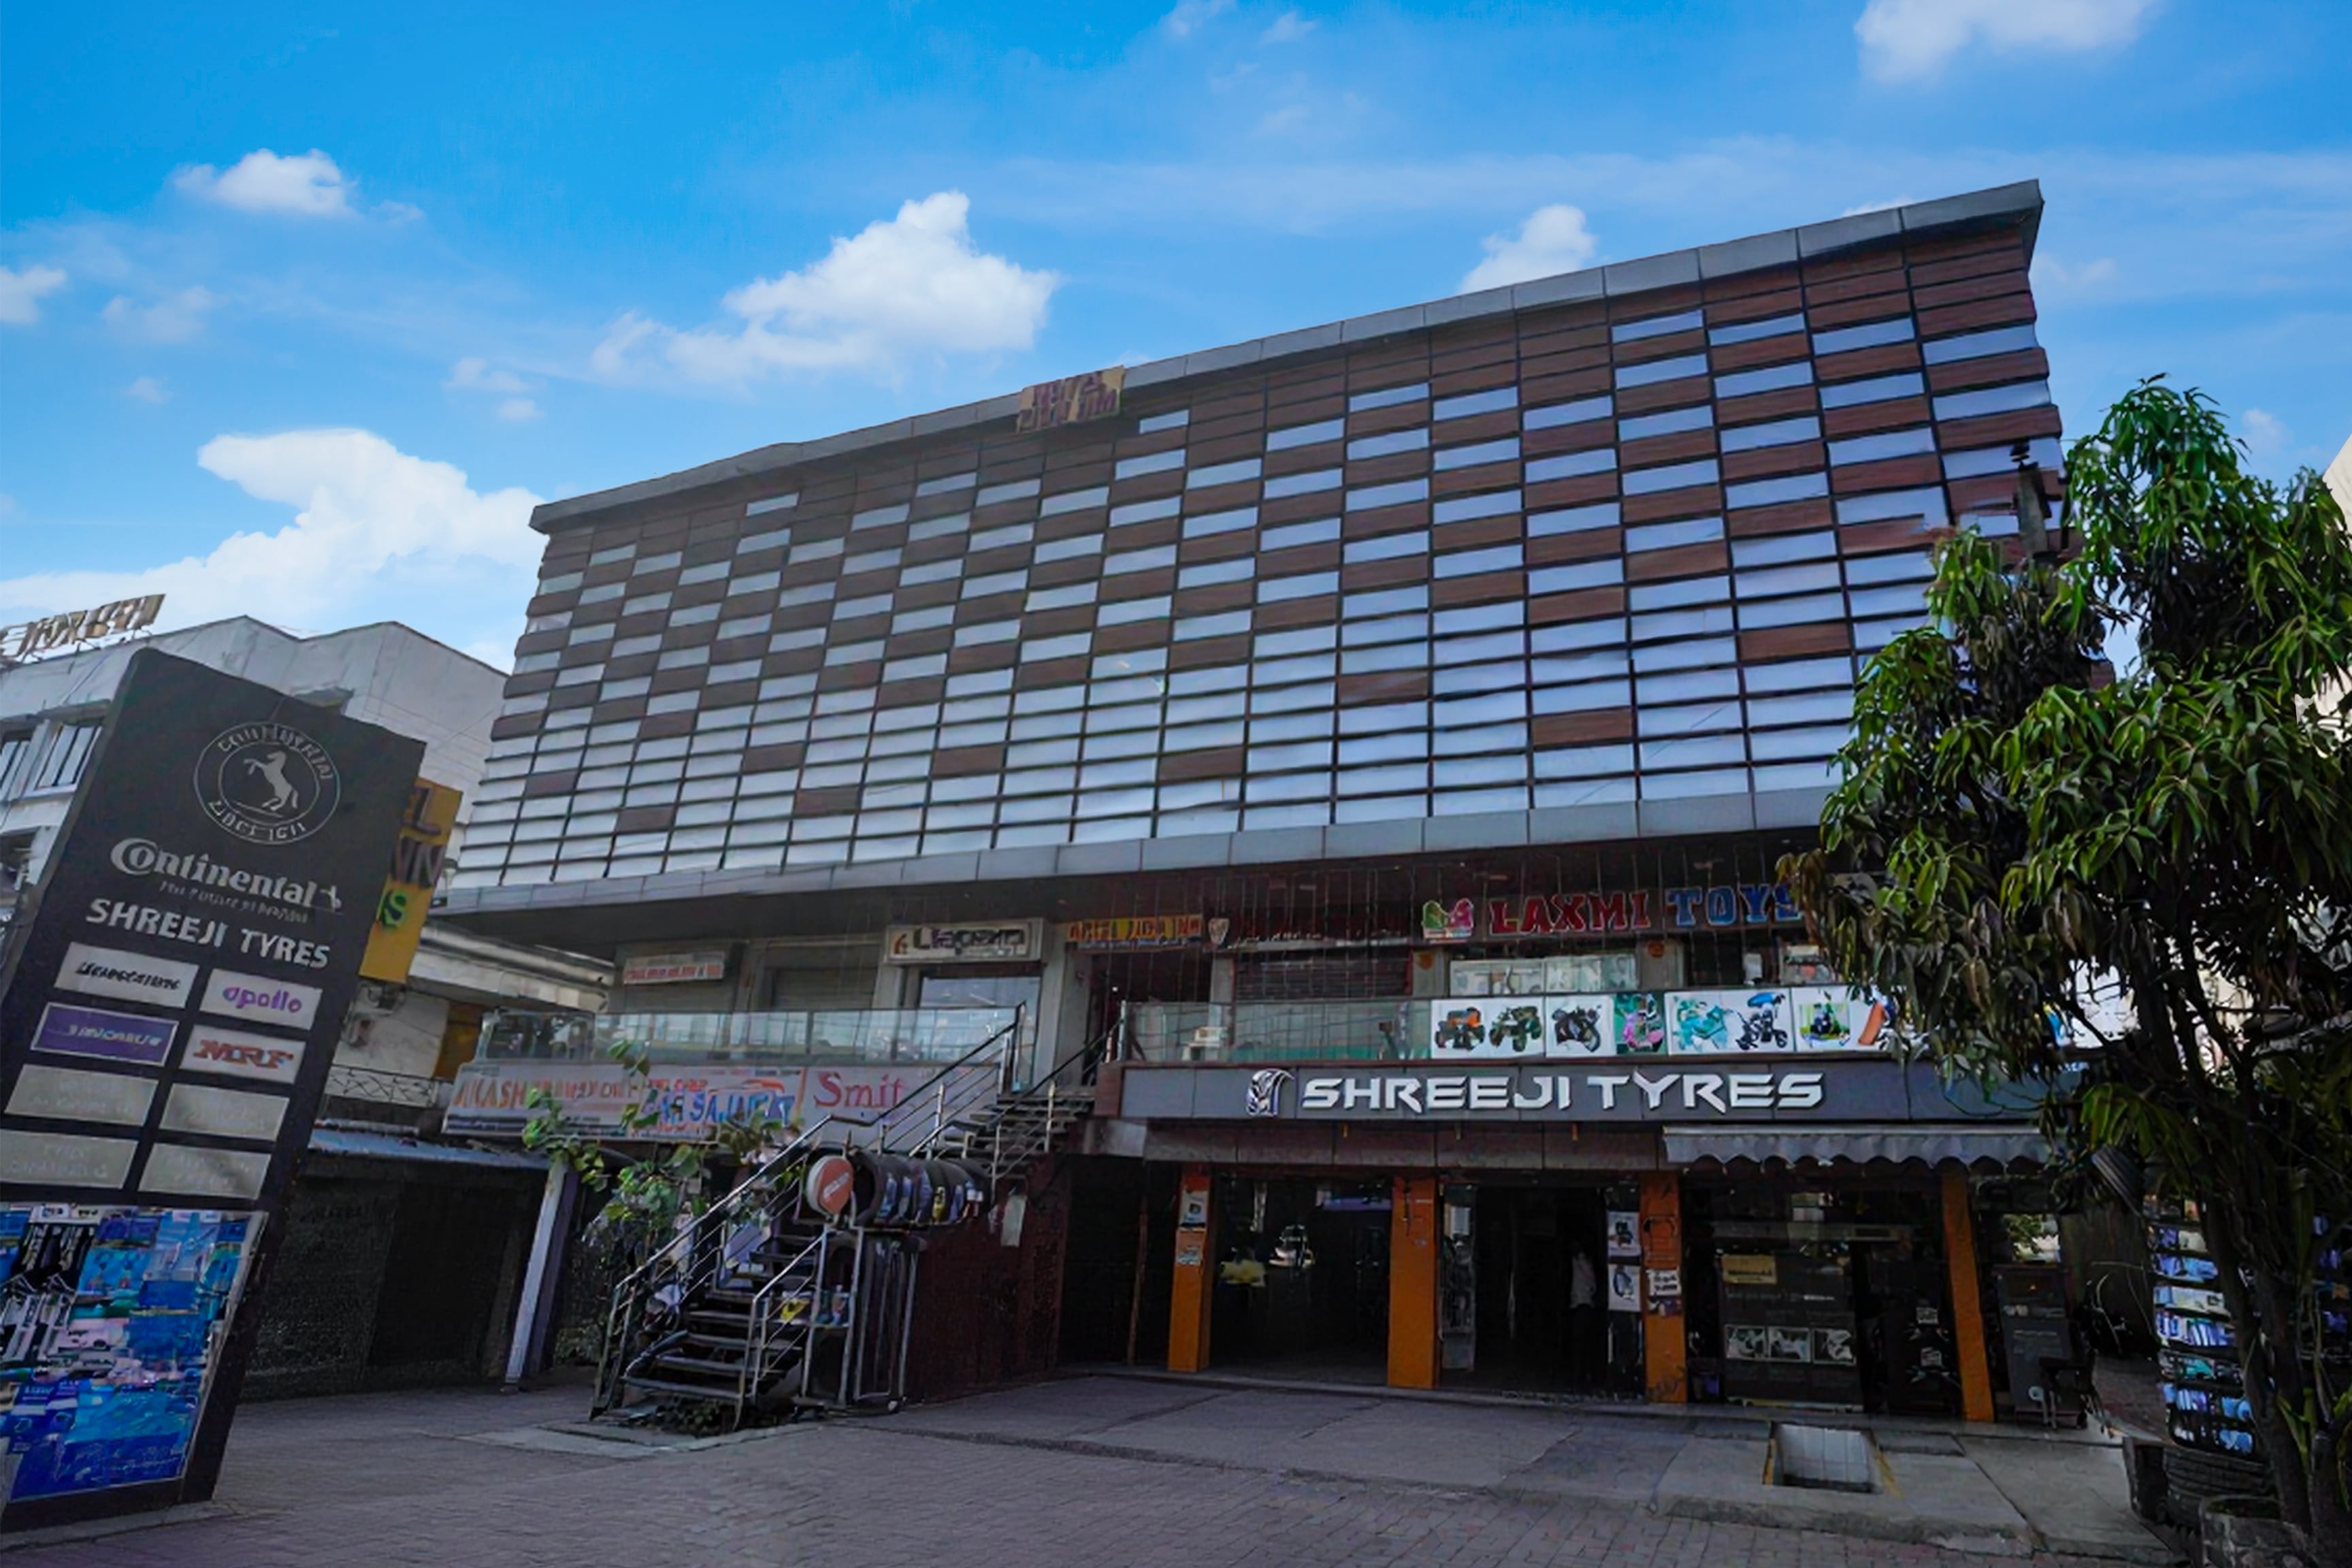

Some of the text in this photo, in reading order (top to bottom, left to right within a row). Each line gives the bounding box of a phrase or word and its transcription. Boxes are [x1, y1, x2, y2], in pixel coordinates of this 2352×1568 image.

[110, 837, 318, 908] Continental
[86, 898, 229, 947] SHREEJI
[240, 928, 331, 968] TYRES
[1489, 889, 1652, 936] LAXMI
[222, 987, 302, 1013] apollo
[193, 1039, 295, 1069] MRF
[1302, 1071, 1824, 1114] SHREEJI TYRES
